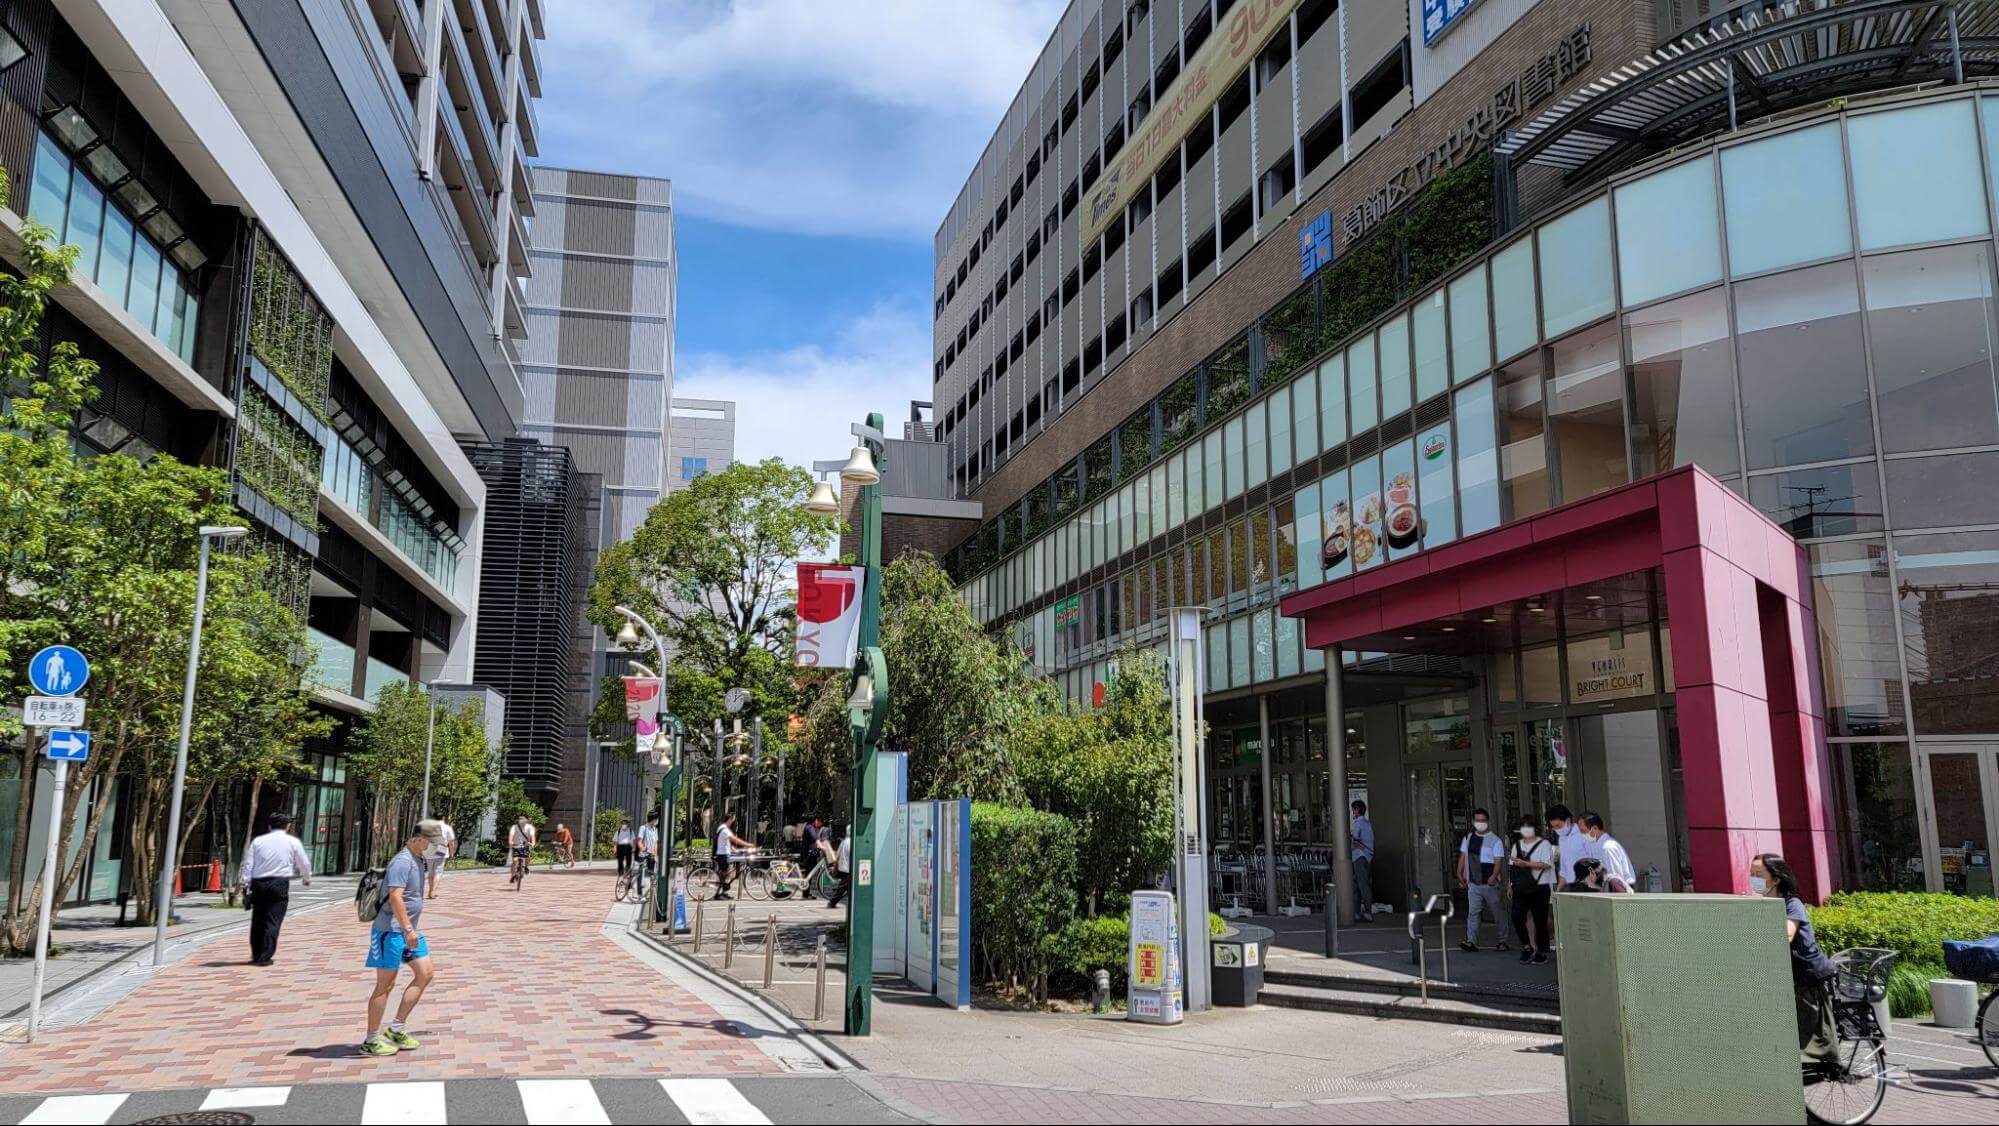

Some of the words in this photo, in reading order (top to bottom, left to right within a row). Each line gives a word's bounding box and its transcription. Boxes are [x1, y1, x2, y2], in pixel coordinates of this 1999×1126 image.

[1342, 21, 1591, 246] 葛飾区立中央図書館
[1577, 680, 1610, 697] BRIGHT
[1611, 673, 1645, 689] COURT
[31, 701, 81, 713] 自転車を除く
